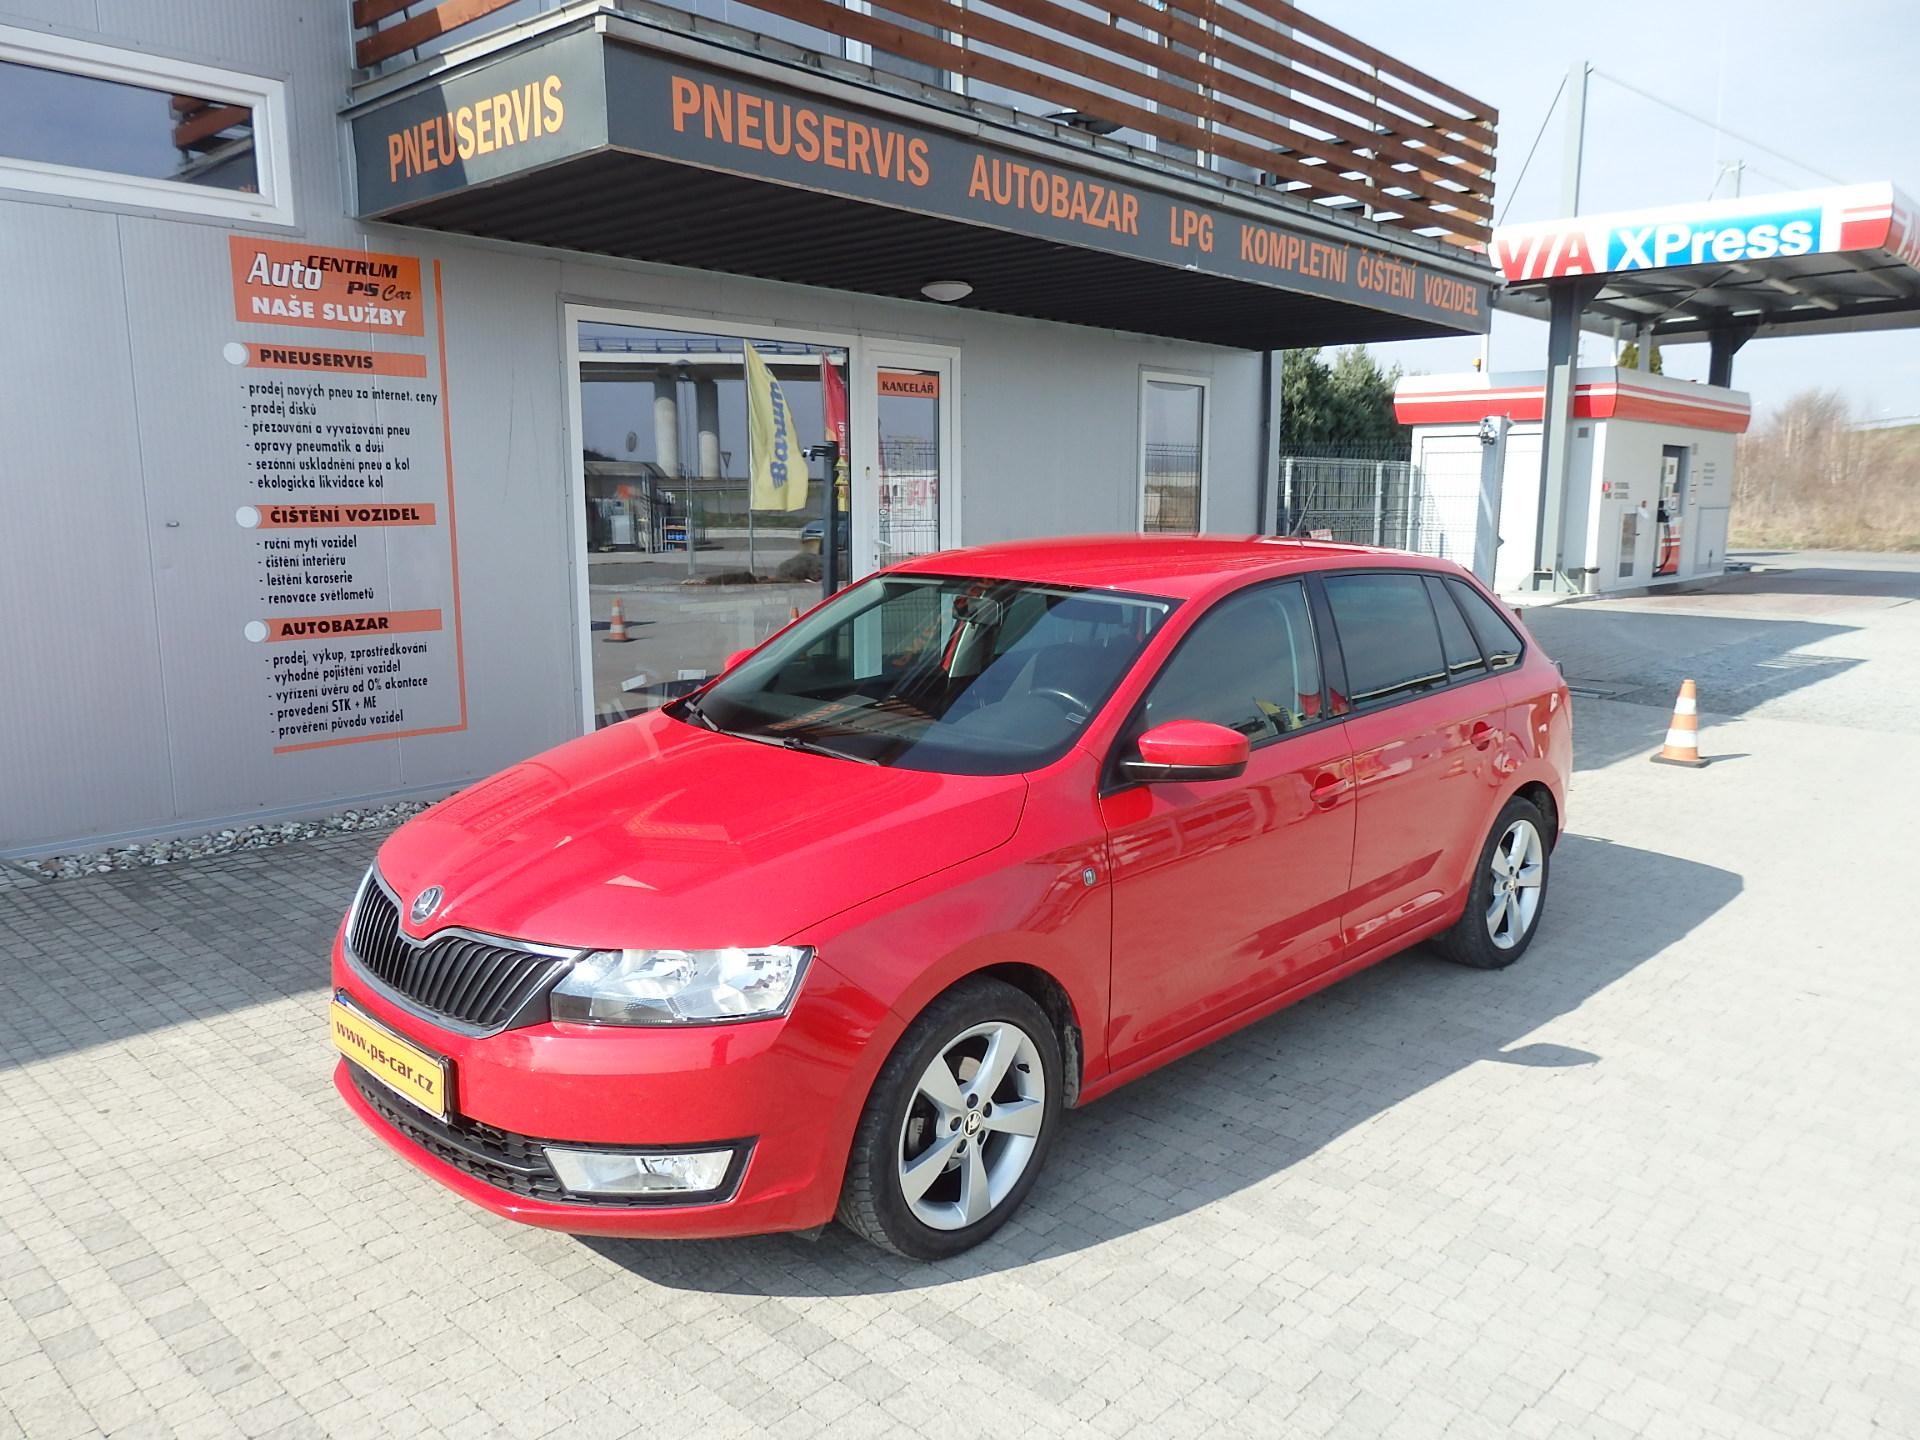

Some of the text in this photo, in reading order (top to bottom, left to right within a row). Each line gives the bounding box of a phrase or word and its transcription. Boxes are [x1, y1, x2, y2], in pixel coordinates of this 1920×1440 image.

[387, 75, 565, 183] PNEUSERVIS
[671, 75, 1479, 316] PNEUSERVIS AUTOBAZAR LPG KOMPLETNÍ ČIŠTĚNÍ VOZIDEL
[1496, 220, 1813, 281] VIA XPress
[246, 252, 398, 290] Auto CENTRUM
[347, 281, 413, 301] PS Car
[252, 295, 407, 326] NAŠE SLUŽBY
[260, 349, 373, 368] PNEUSERVIS
[249, 381, 284, 399] prodej
[287, 384, 324, 400] nových
[328, 388, 353, 401] pneu
[356, 389, 368, 399] za
[415, 393, 438, 406] ceny
[882, 380, 934, 394] KANCELÁŘ
[251, 400, 285, 418] prodej
[252, 420, 410, 438] přezouvání a vyvažování pneu
[254, 442, 292, 455] opravy
[296, 439, 351, 455] pneumatik
[355, 444, 361, 453] a
[358, 461, 382, 473] pneu
[385, 462, 391, 470] a
[395, 457, 410, 470] kol
[257, 474, 384, 492] ekologická likvidace kol
[270, 506, 420, 523] ČIŠTĚNÍ VOZIDEL
[321, 534, 357, 548] vozidel
[305, 570, 353, 584] karoserie
[268, 592, 317, 604] renovace
[281, 617, 389, 636] AUTOBAZAR
[367, 659, 401, 674] vozidel
[352, 680, 364, 693] od
[367, 678, 382, 691] 0%
[385, 676, 428, 690] akontace
[332, 698, 351, 713] STK
[363, 696, 377, 709] ME
[369, 709, 404, 725] vozidel
[336, 1021, 434, 1095] www.ps-car.cz
